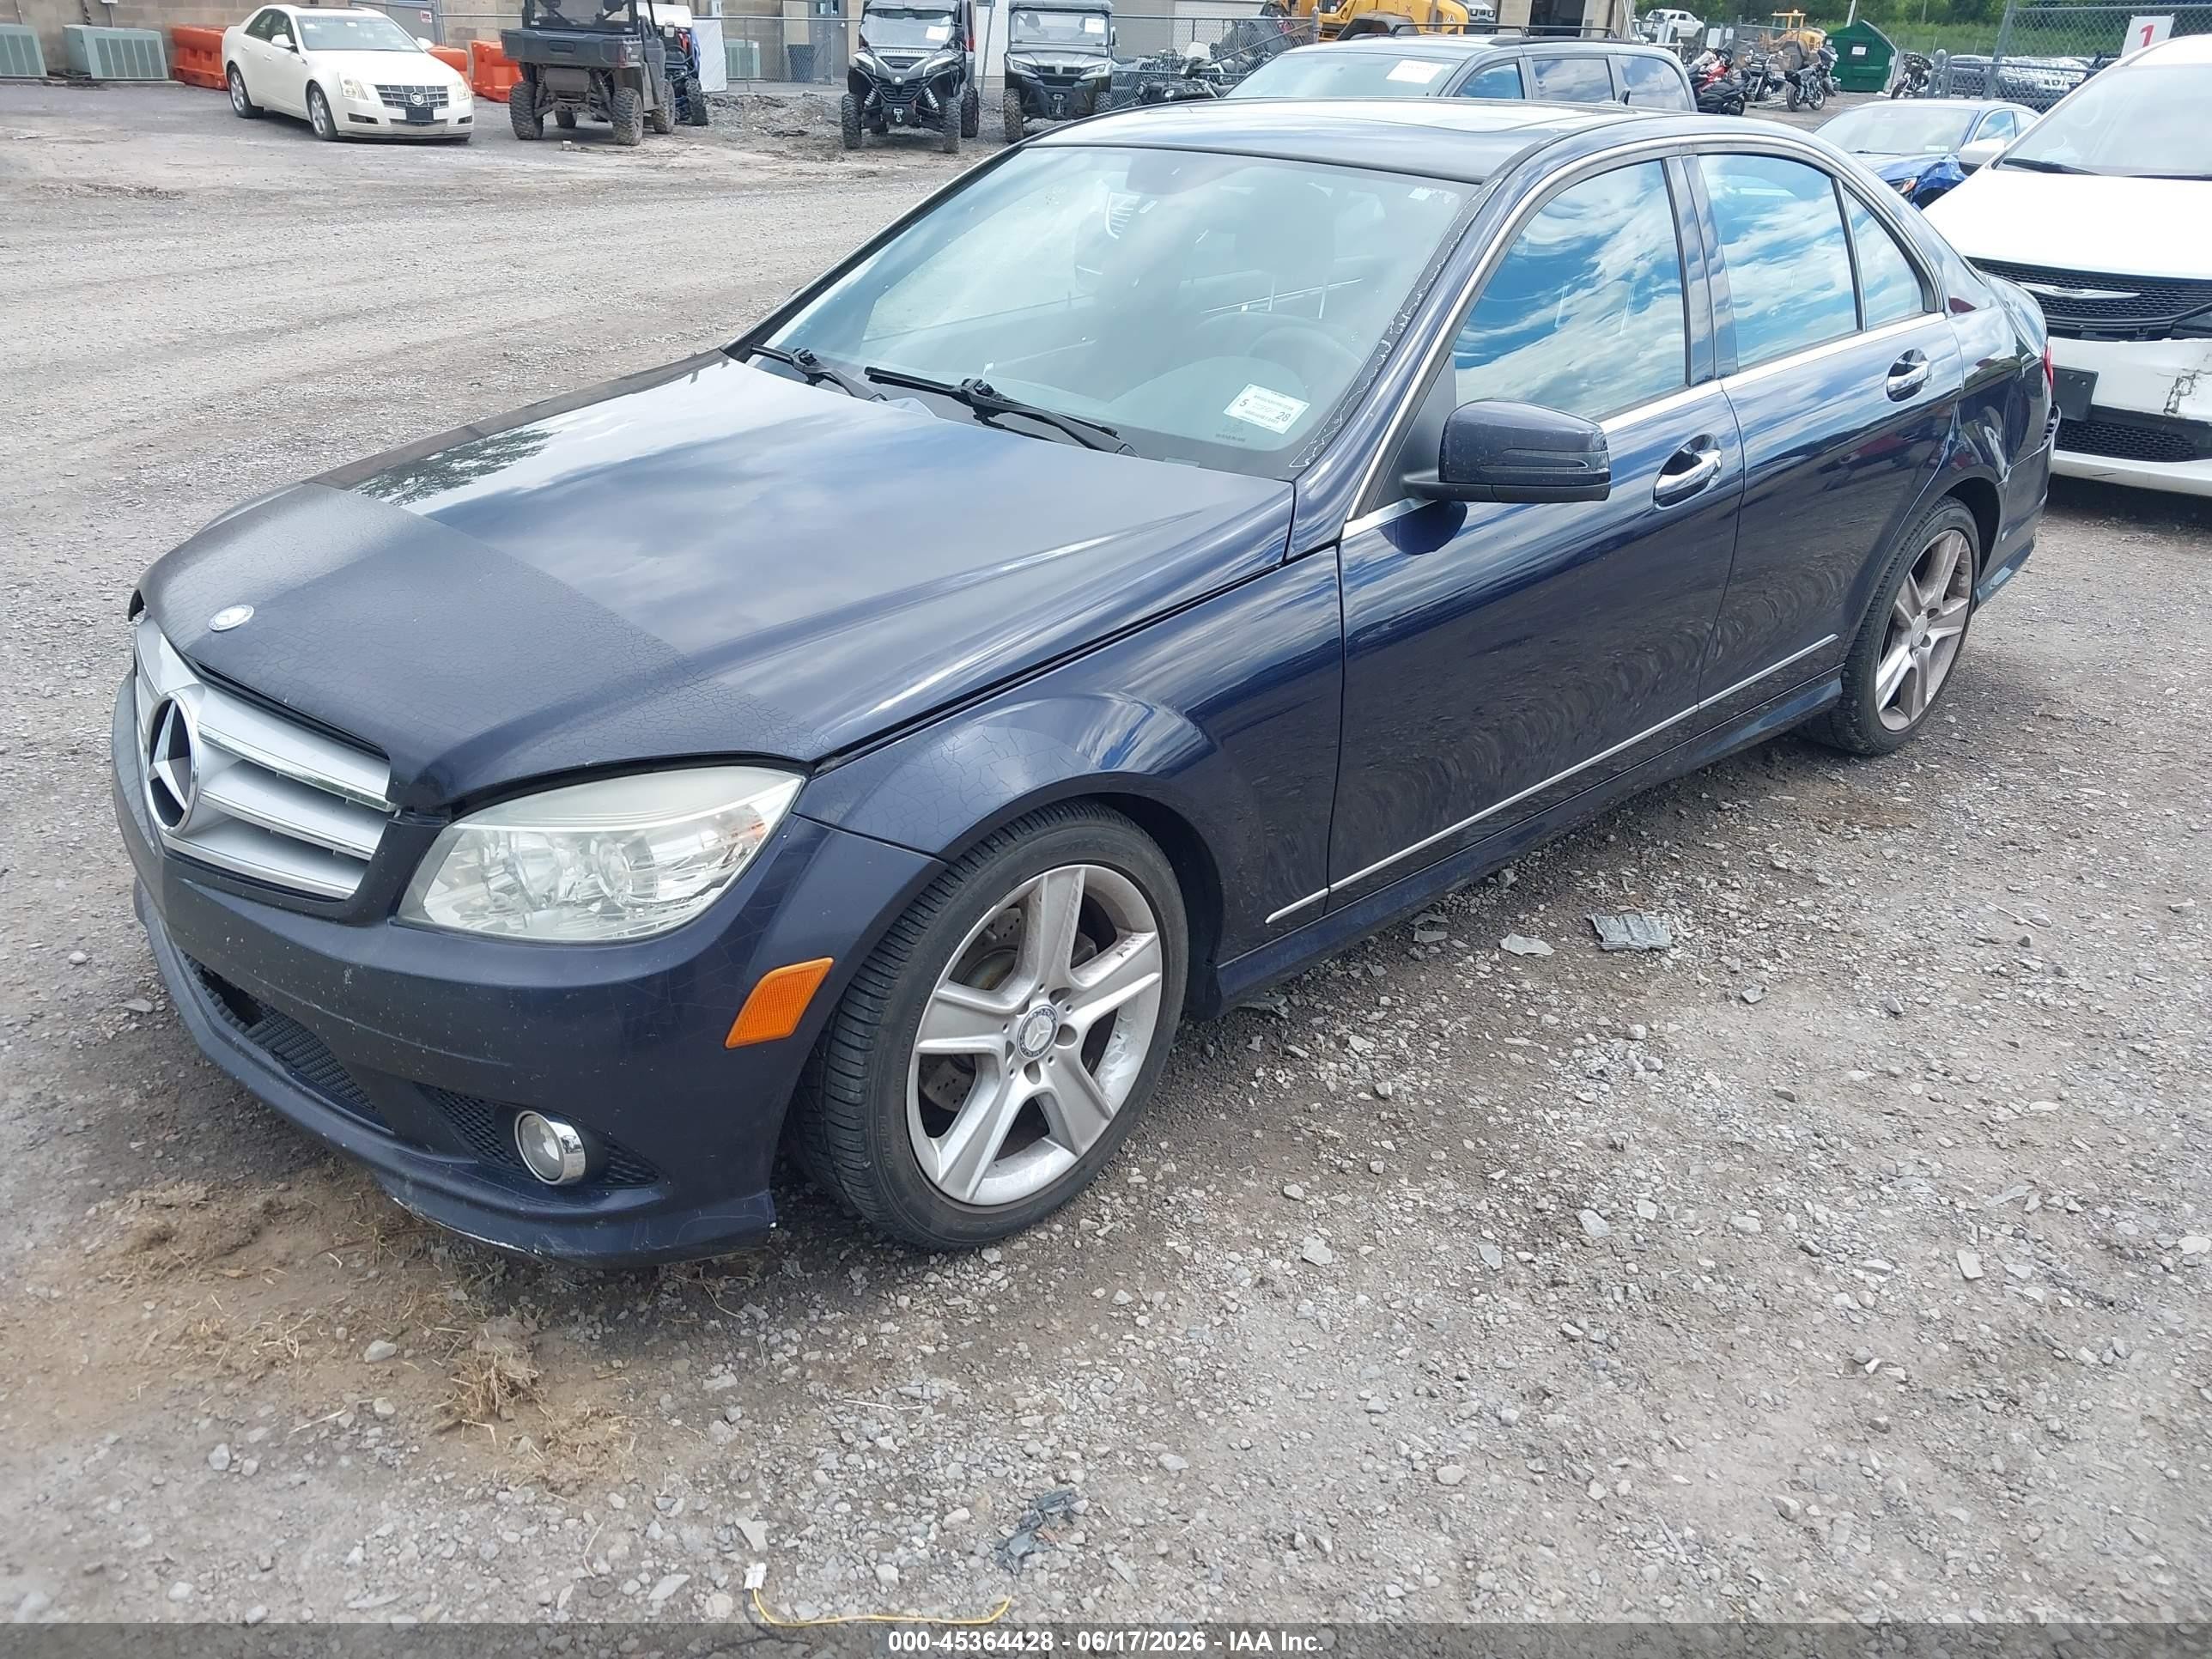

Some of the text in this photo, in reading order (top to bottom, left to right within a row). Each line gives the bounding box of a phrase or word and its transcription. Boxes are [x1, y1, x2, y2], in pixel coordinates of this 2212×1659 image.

[2139, 24, 2154, 48] 1
[1239, 398, 1250, 408] 5
[1275, 411, 1291, 422] 28
